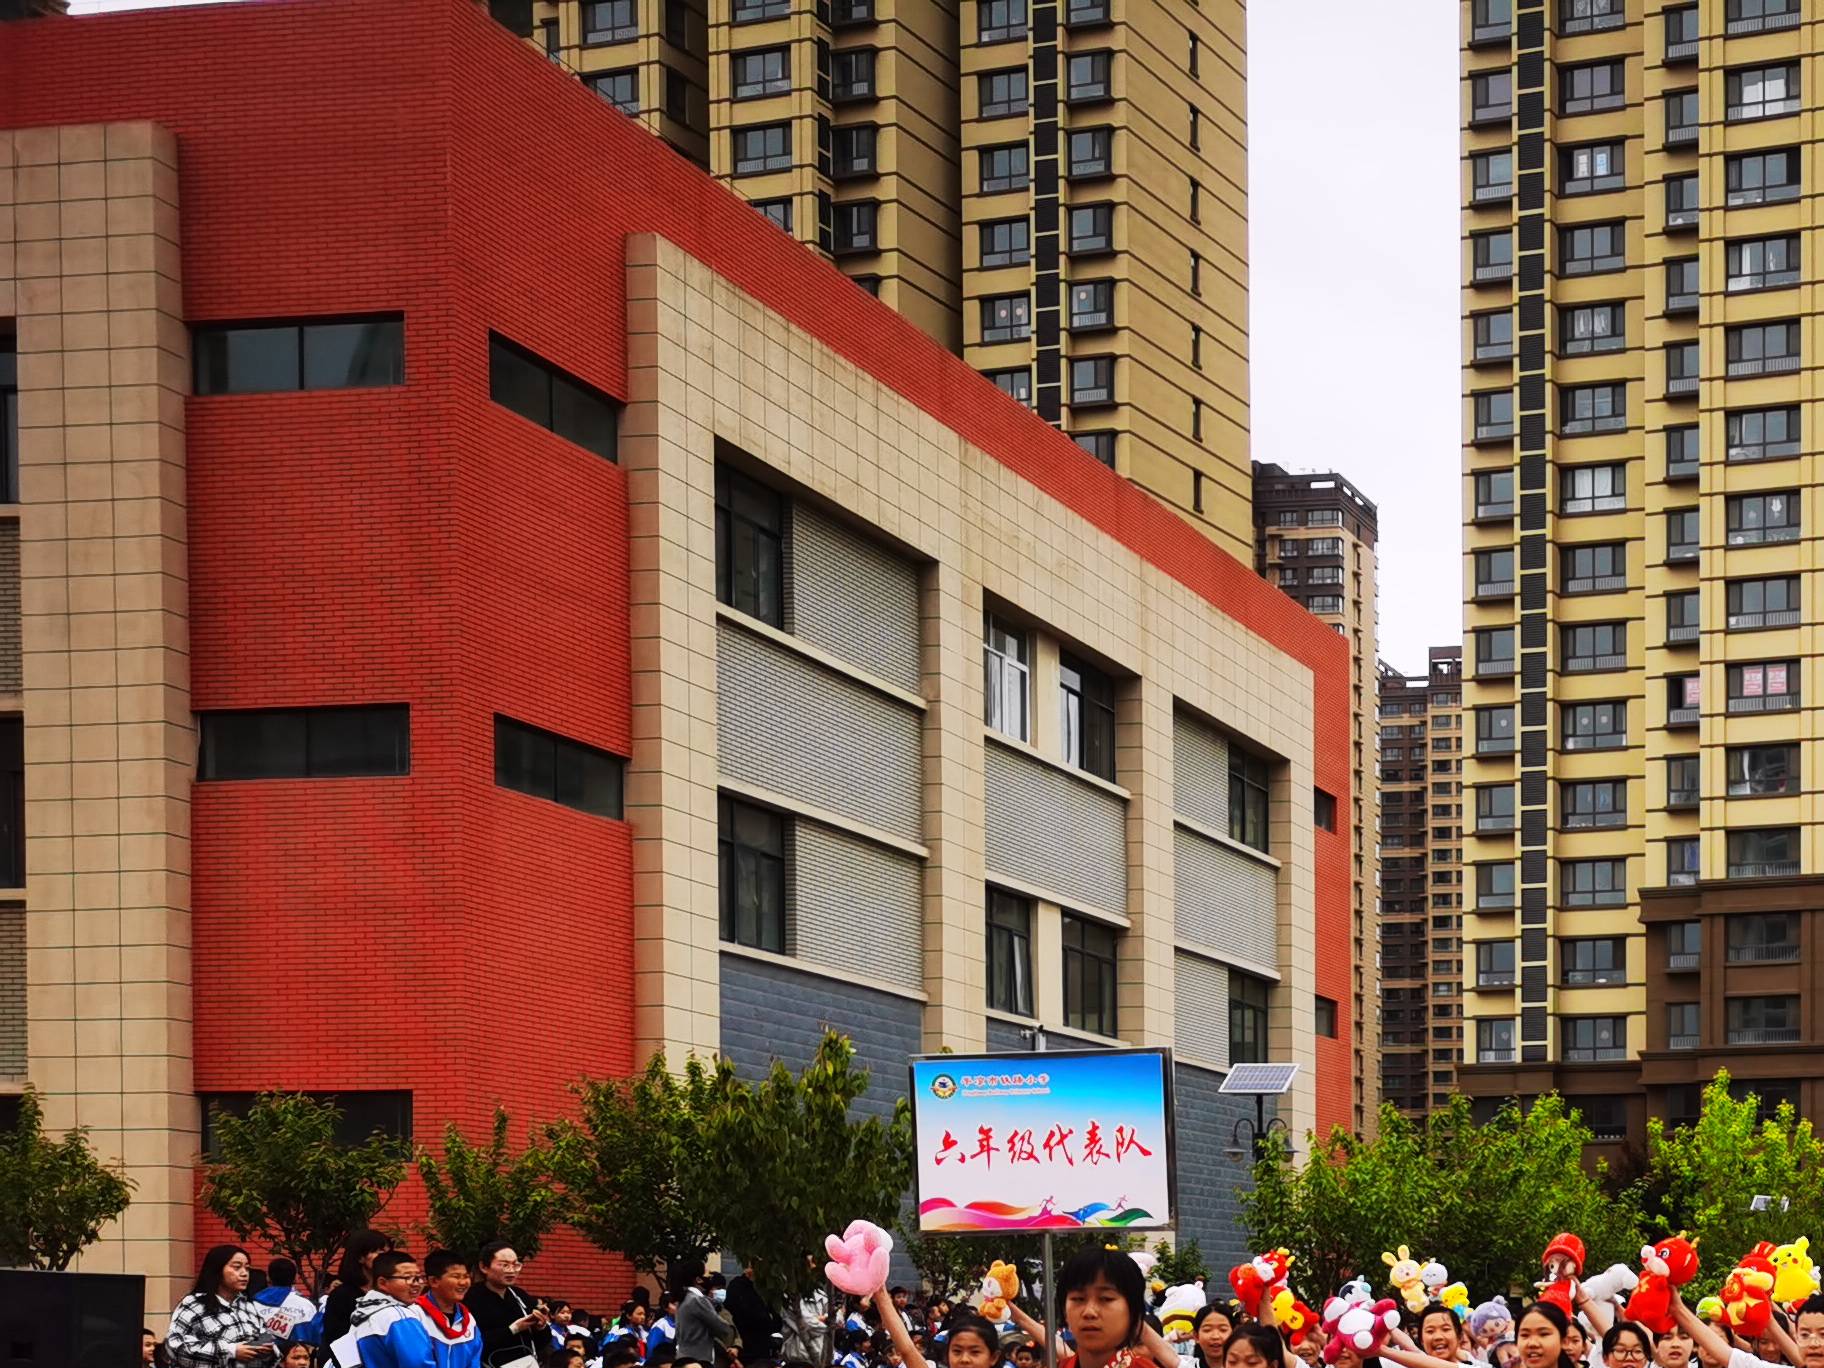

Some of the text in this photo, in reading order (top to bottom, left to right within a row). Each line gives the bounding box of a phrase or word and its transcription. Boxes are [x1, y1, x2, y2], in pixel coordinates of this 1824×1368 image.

[934, 1120, 1153, 1172] 六年级代表队
